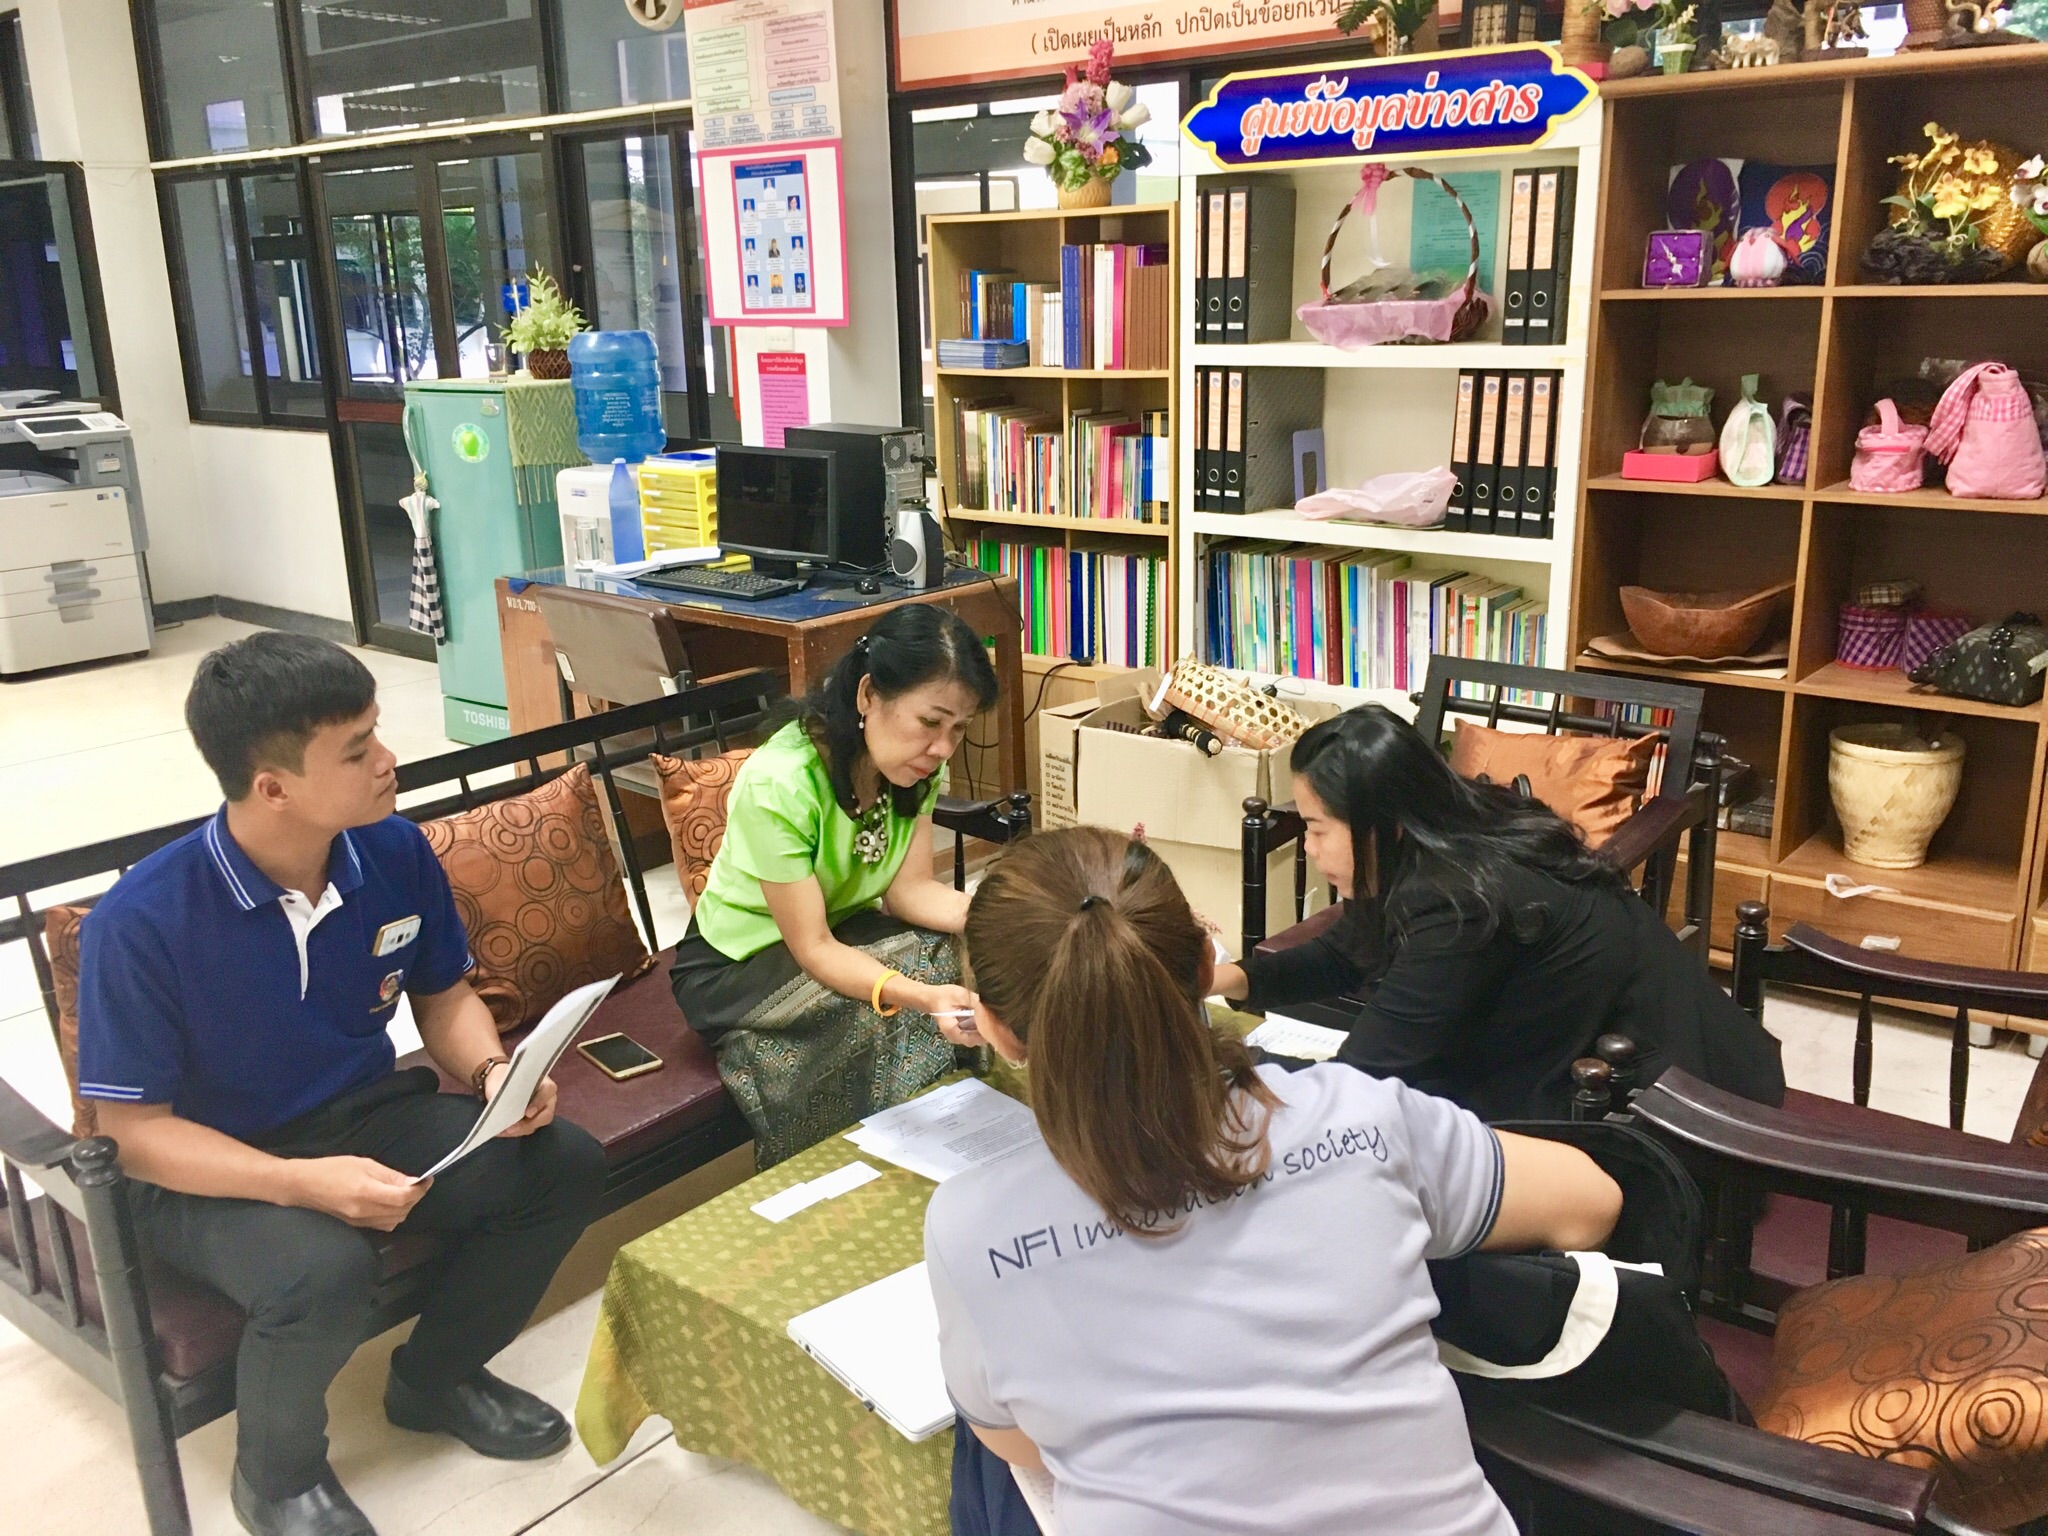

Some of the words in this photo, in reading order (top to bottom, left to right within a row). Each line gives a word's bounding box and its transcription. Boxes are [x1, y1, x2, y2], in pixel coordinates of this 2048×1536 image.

[1043, 13, 1163, 52] เปิดเผยเป็นหลัก
[1175, 0, 1342, 36] ปกปิดเป็นข้อยกเวน
[1240, 71, 1544, 156] ศูนย์ข้อมูลข่าวสาร
[987, 1224, 1063, 1279] NFI
[1073, 1168, 1275, 1250] Innovaon
[1282, 1124, 1389, 1176] society
